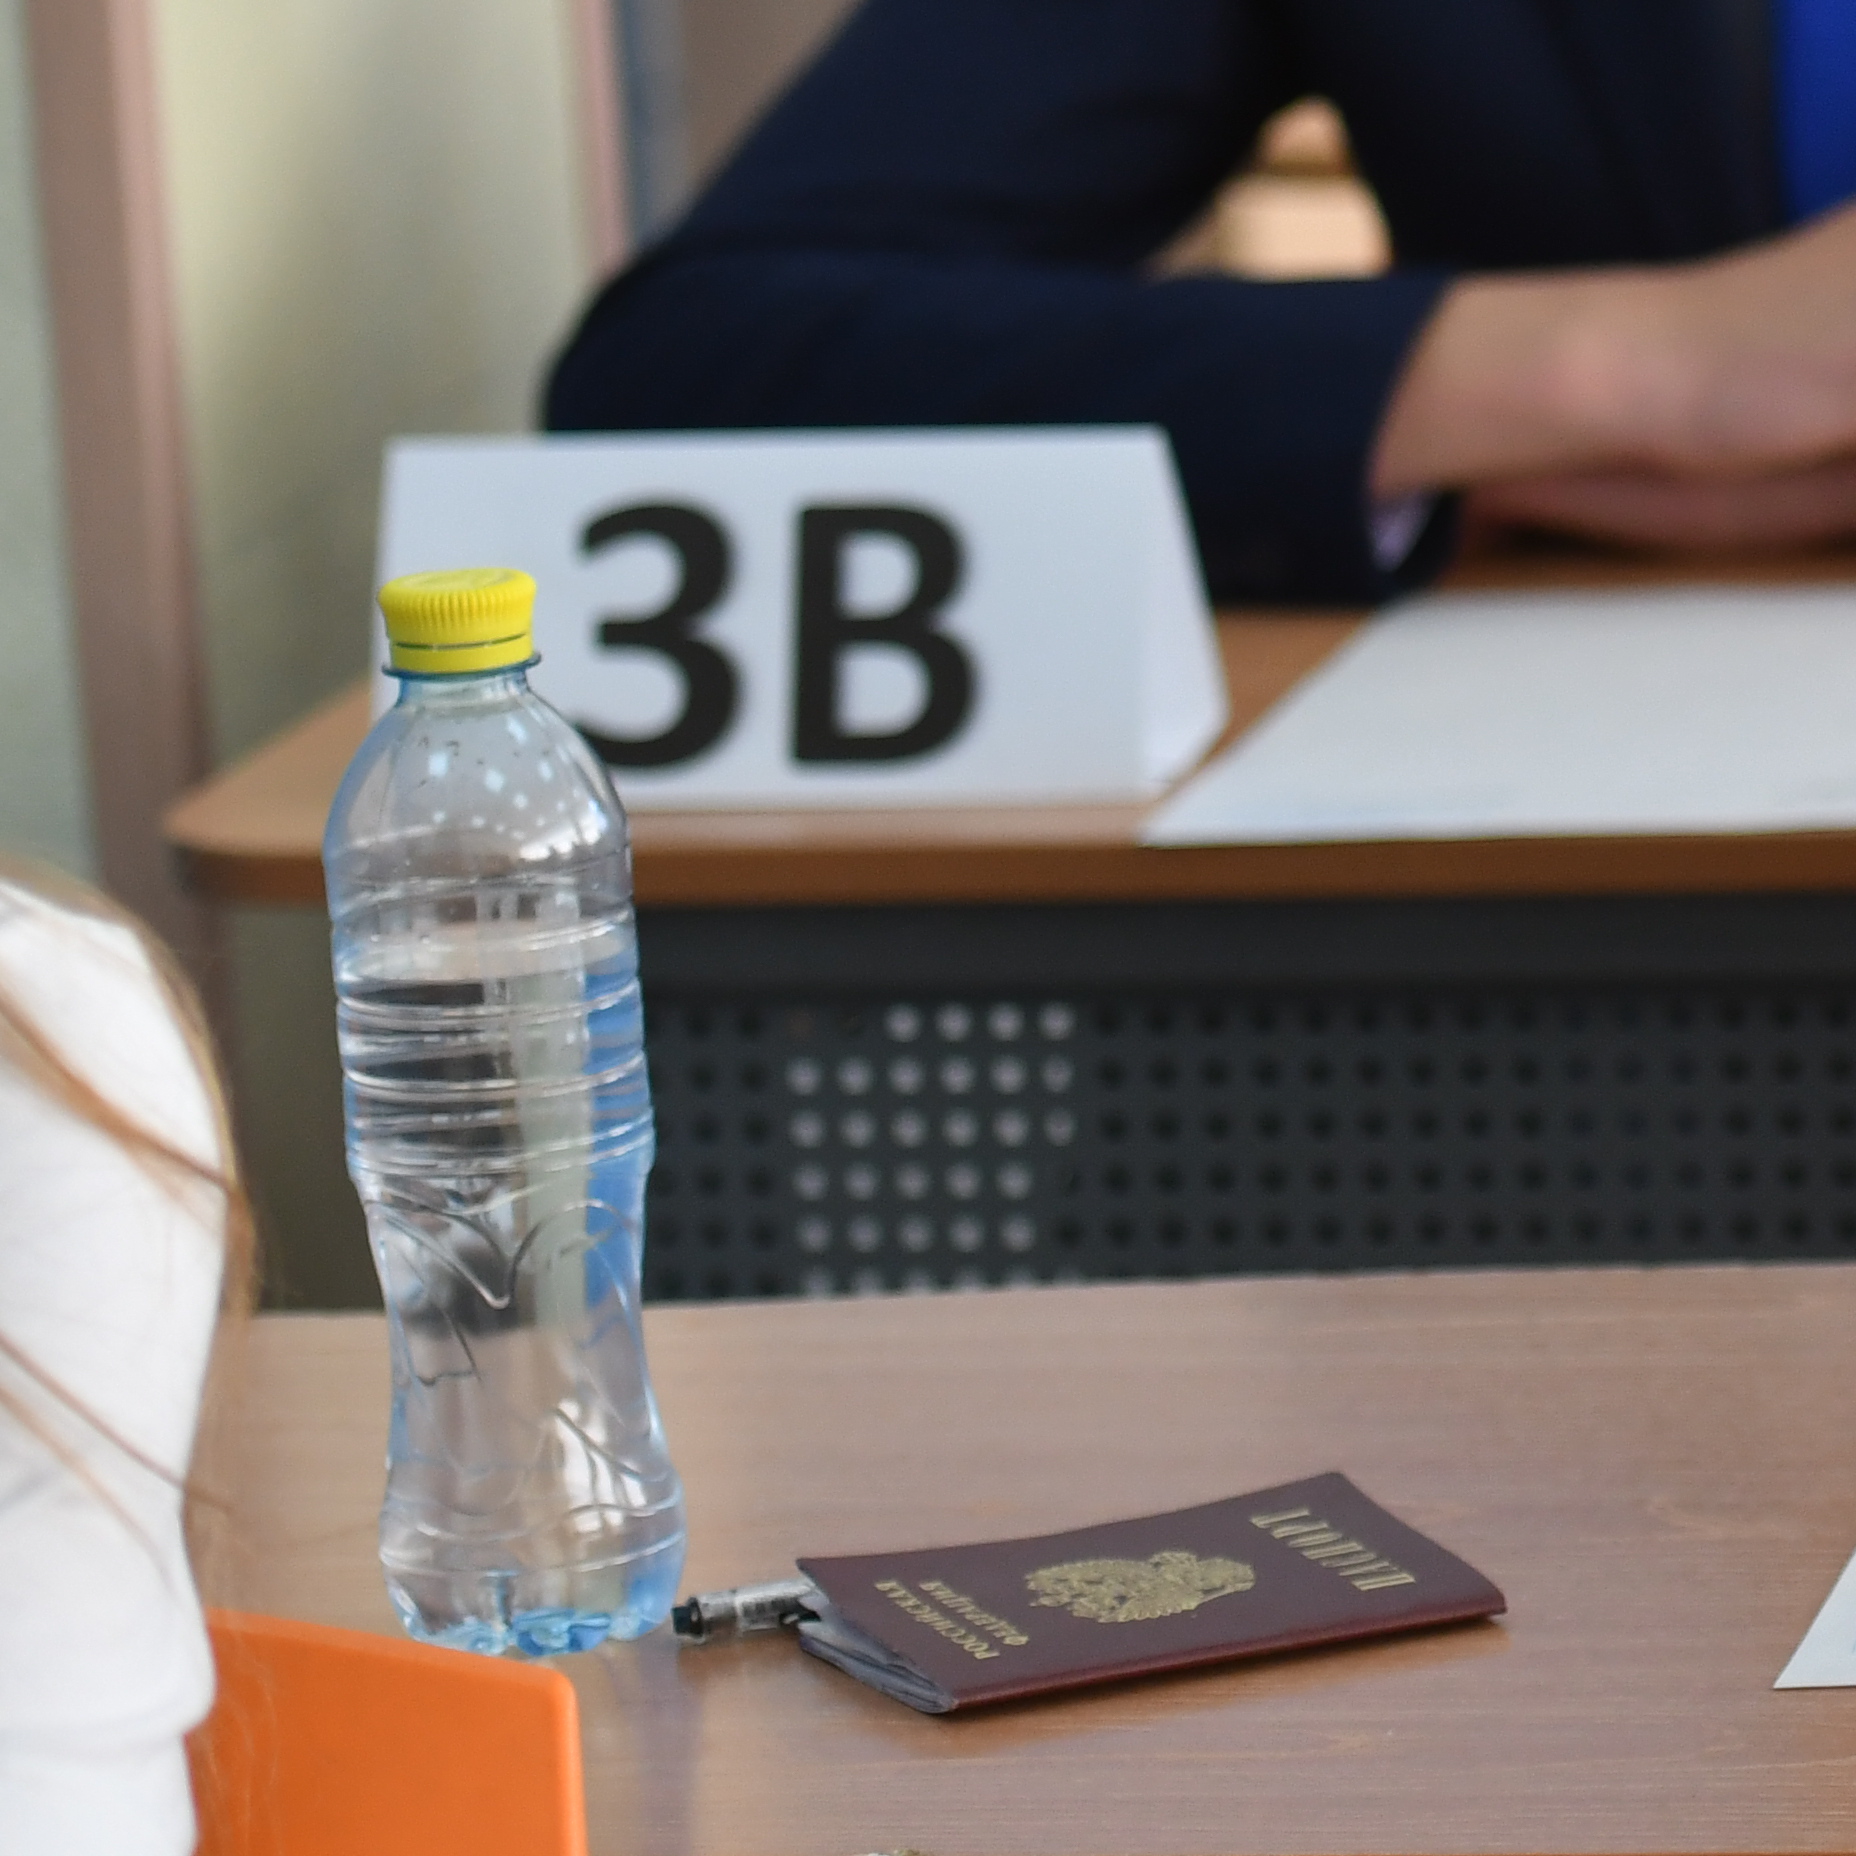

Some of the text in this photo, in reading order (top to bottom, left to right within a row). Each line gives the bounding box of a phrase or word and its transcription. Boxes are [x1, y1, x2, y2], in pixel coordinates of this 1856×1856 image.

[1249, 1508, 1416, 1591] ПАСПОРТ
[874, 1580, 1000, 1660] РОССИЙСКАЯ
[919, 1580, 1030, 1646] ФЕДЕРАЦИЯ
